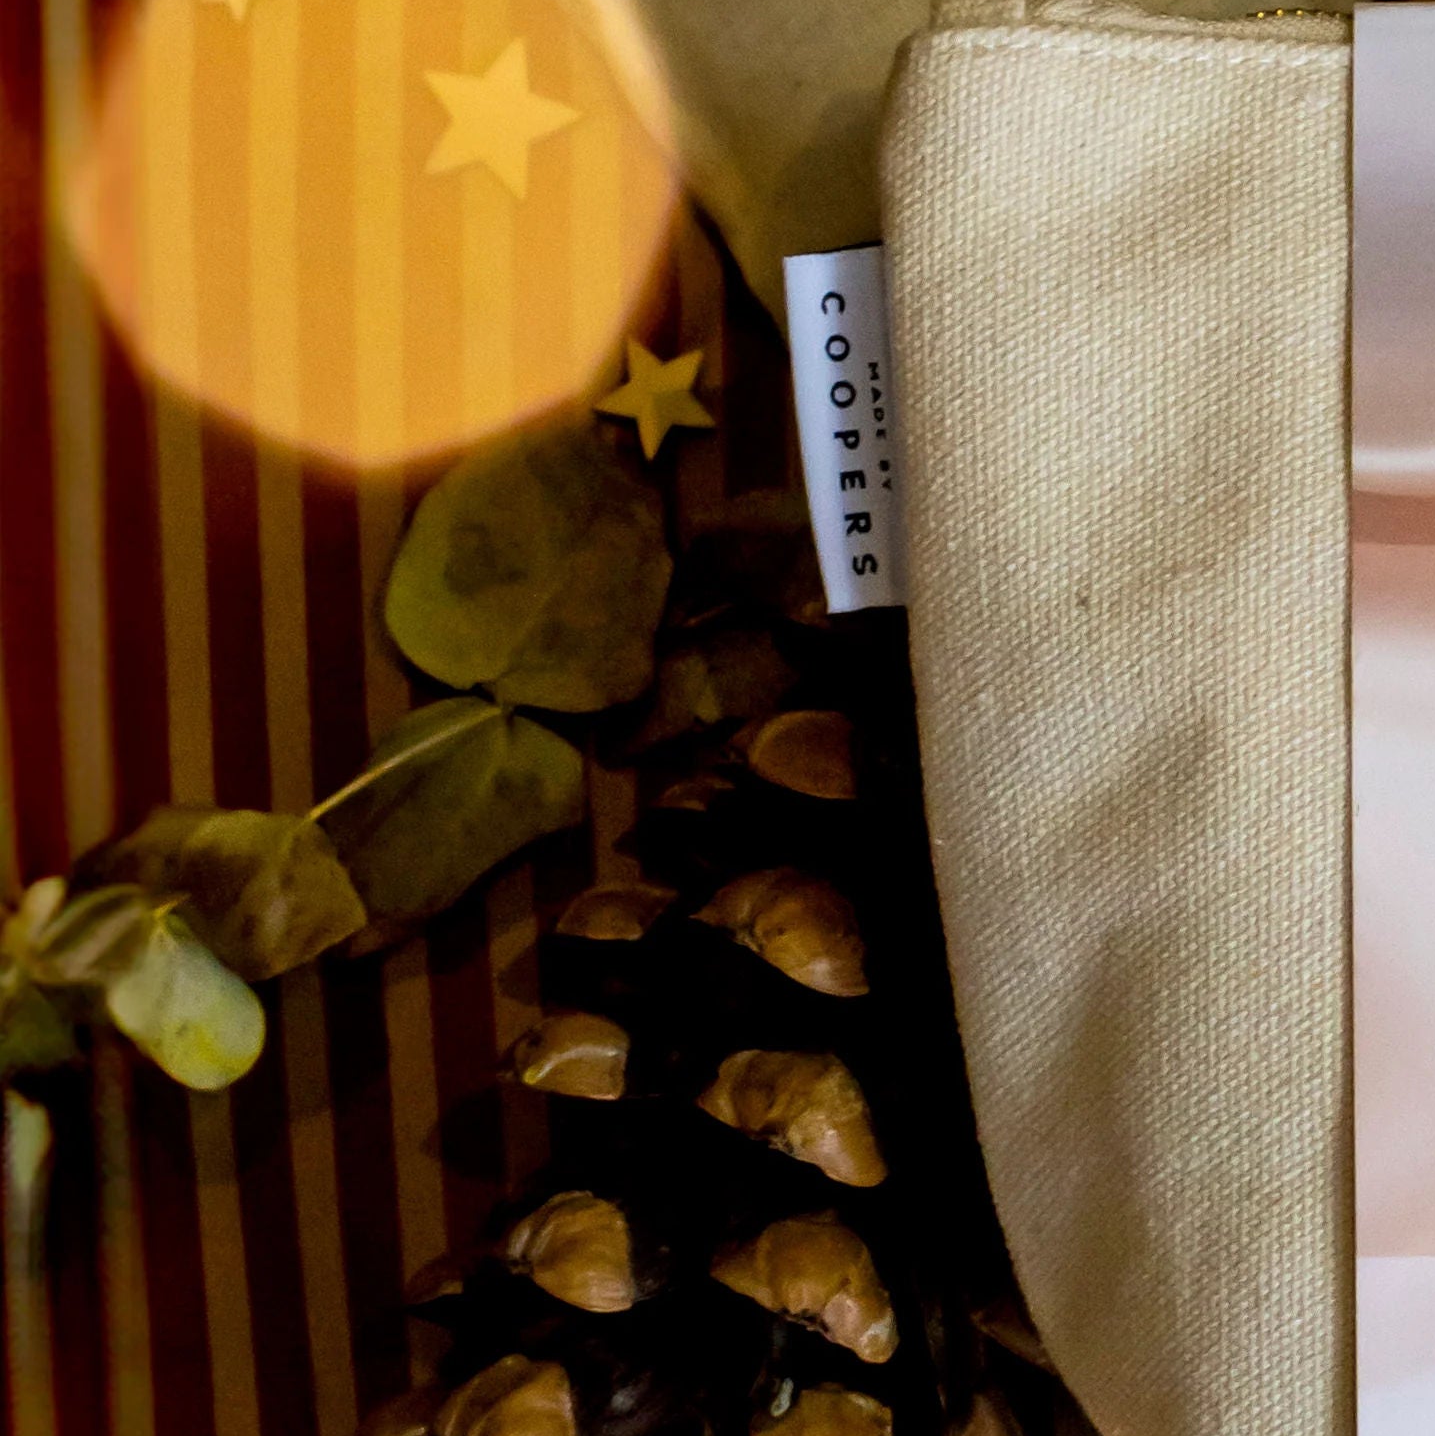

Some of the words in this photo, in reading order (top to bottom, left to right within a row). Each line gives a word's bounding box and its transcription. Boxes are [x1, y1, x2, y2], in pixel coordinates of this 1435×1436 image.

[822, 291, 877, 576] COOPERS
[868, 362, 886, 440] MADE
[878, 459, 893, 490] BY
